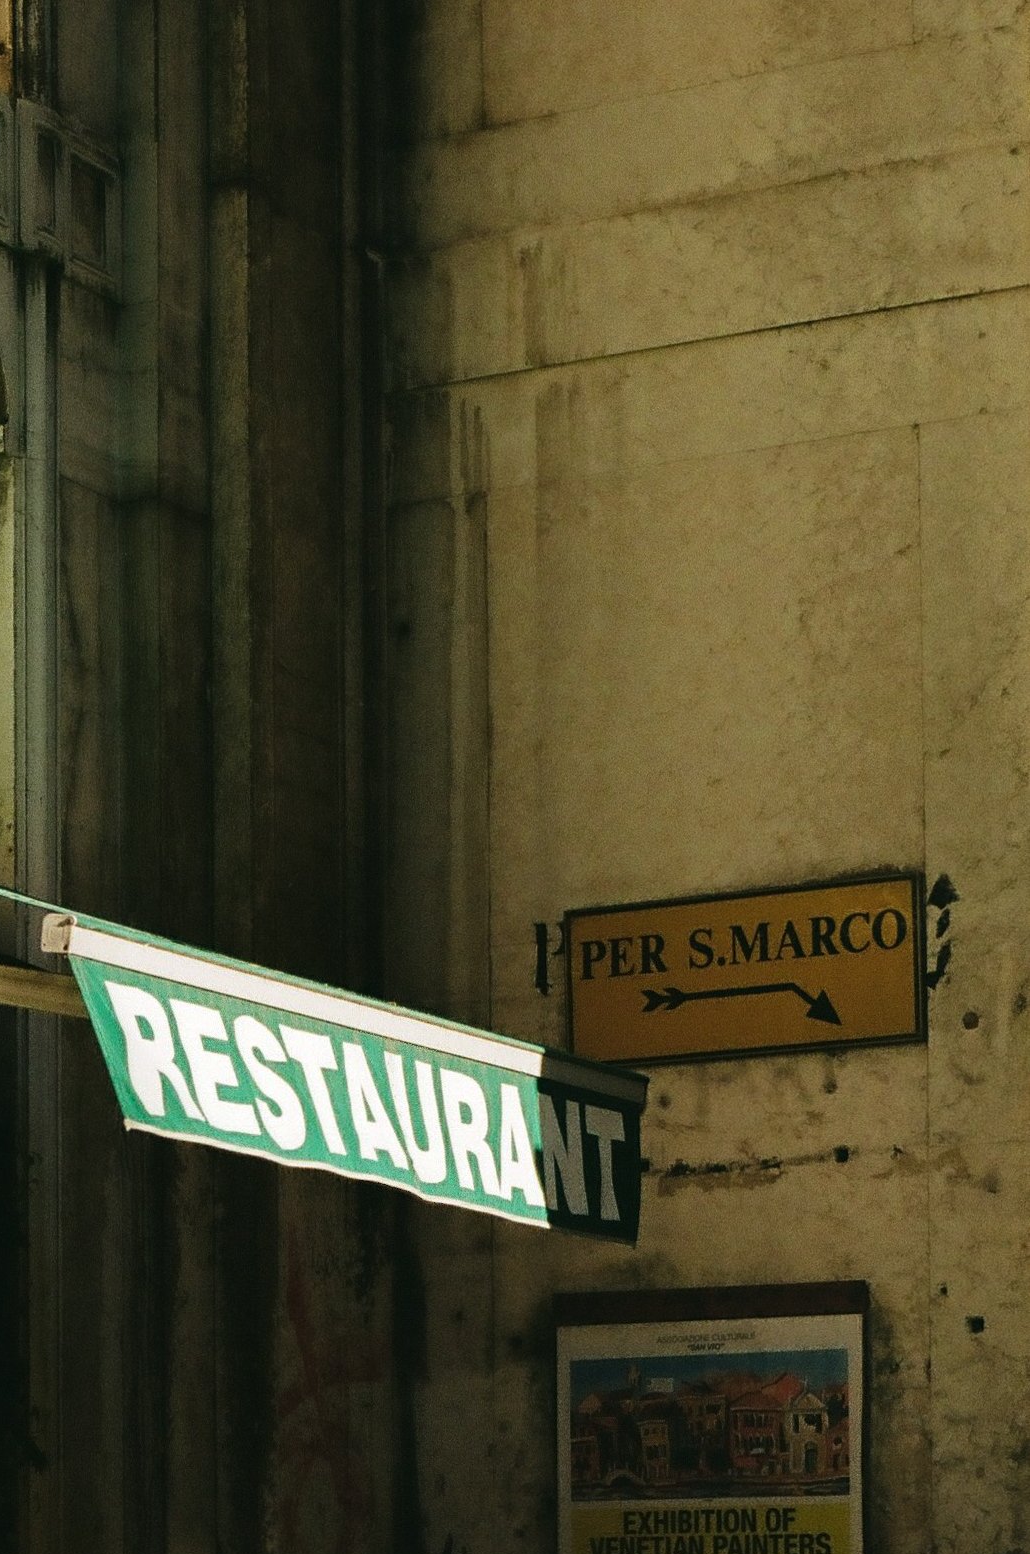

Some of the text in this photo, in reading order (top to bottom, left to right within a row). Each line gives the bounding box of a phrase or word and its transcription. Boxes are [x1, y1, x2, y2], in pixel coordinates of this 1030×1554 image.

[580, 934, 668, 981] PER
[688, 907, 907, 970] S.MARCO
[104, 980, 626, 1222] RESTAURANT
[622, 1507, 796, 1535] EXHIBITION OF
